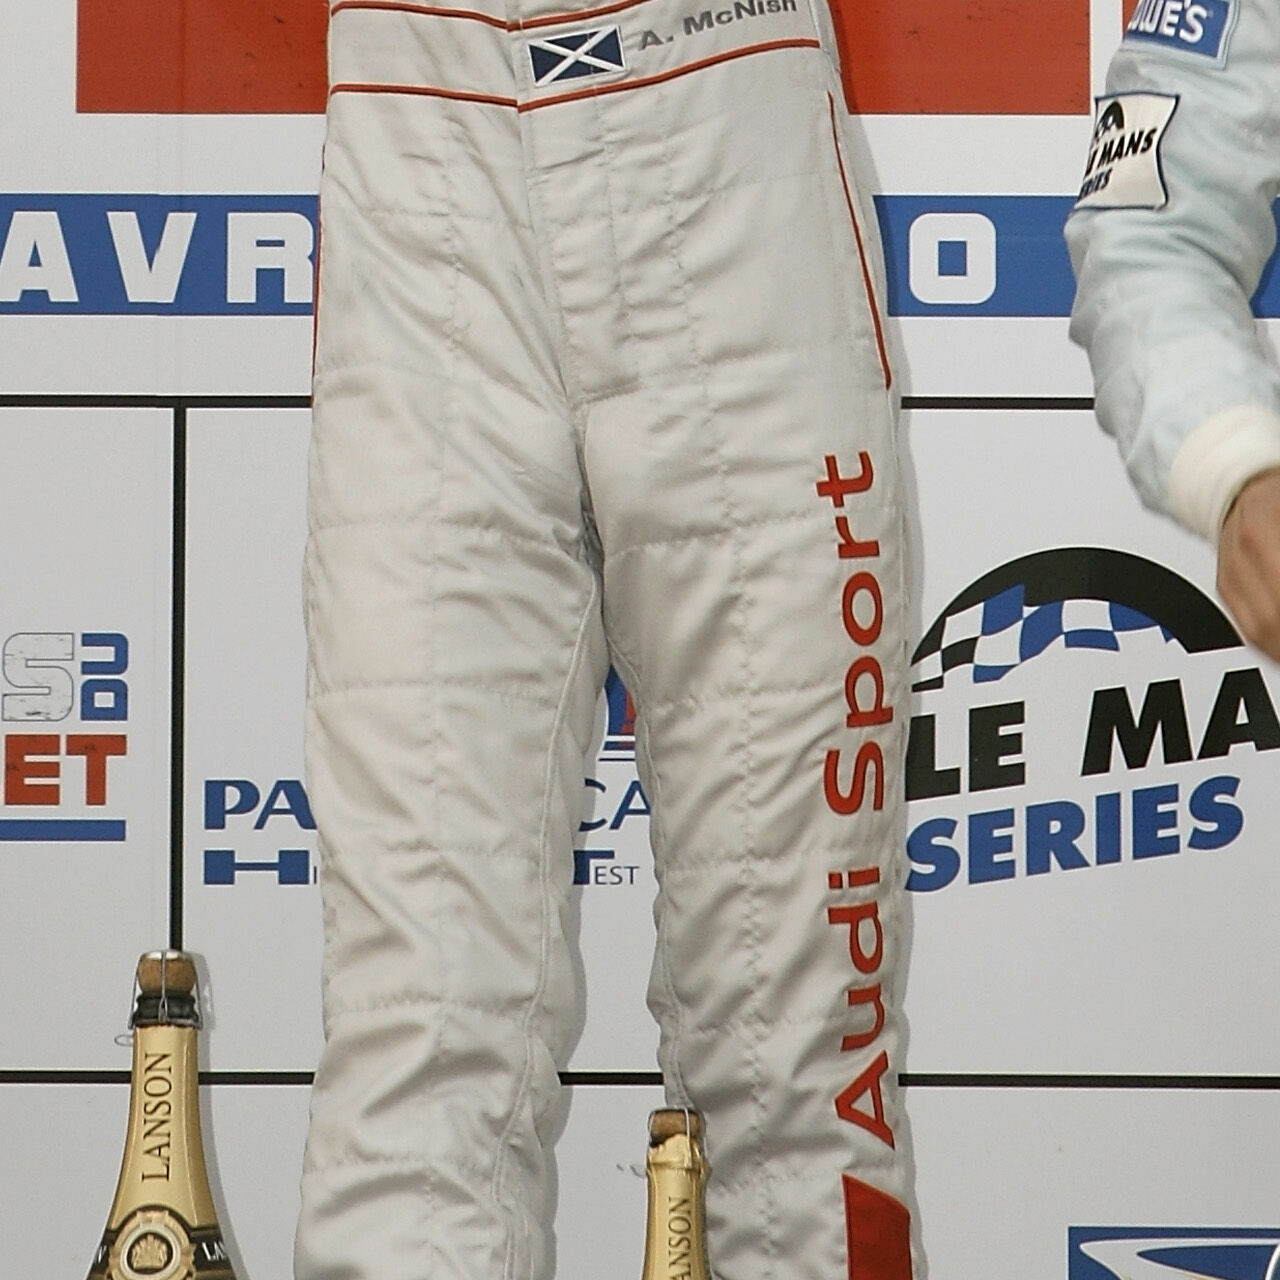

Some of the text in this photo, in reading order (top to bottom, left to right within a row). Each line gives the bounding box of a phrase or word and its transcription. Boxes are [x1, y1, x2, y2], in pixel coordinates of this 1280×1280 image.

[638, 29, 673, 51] A.
[815, 450, 894, 817] Sport
[905, 667, 1280, 803] LE MA
[204, 779, 318, 831] PA
[904, 775, 1245, 893] SERIES
[827, 865, 897, 1151] Audi
[141, 1051, 172, 1182] LANSON
[668, 1196, 692, 1280] ANSON
